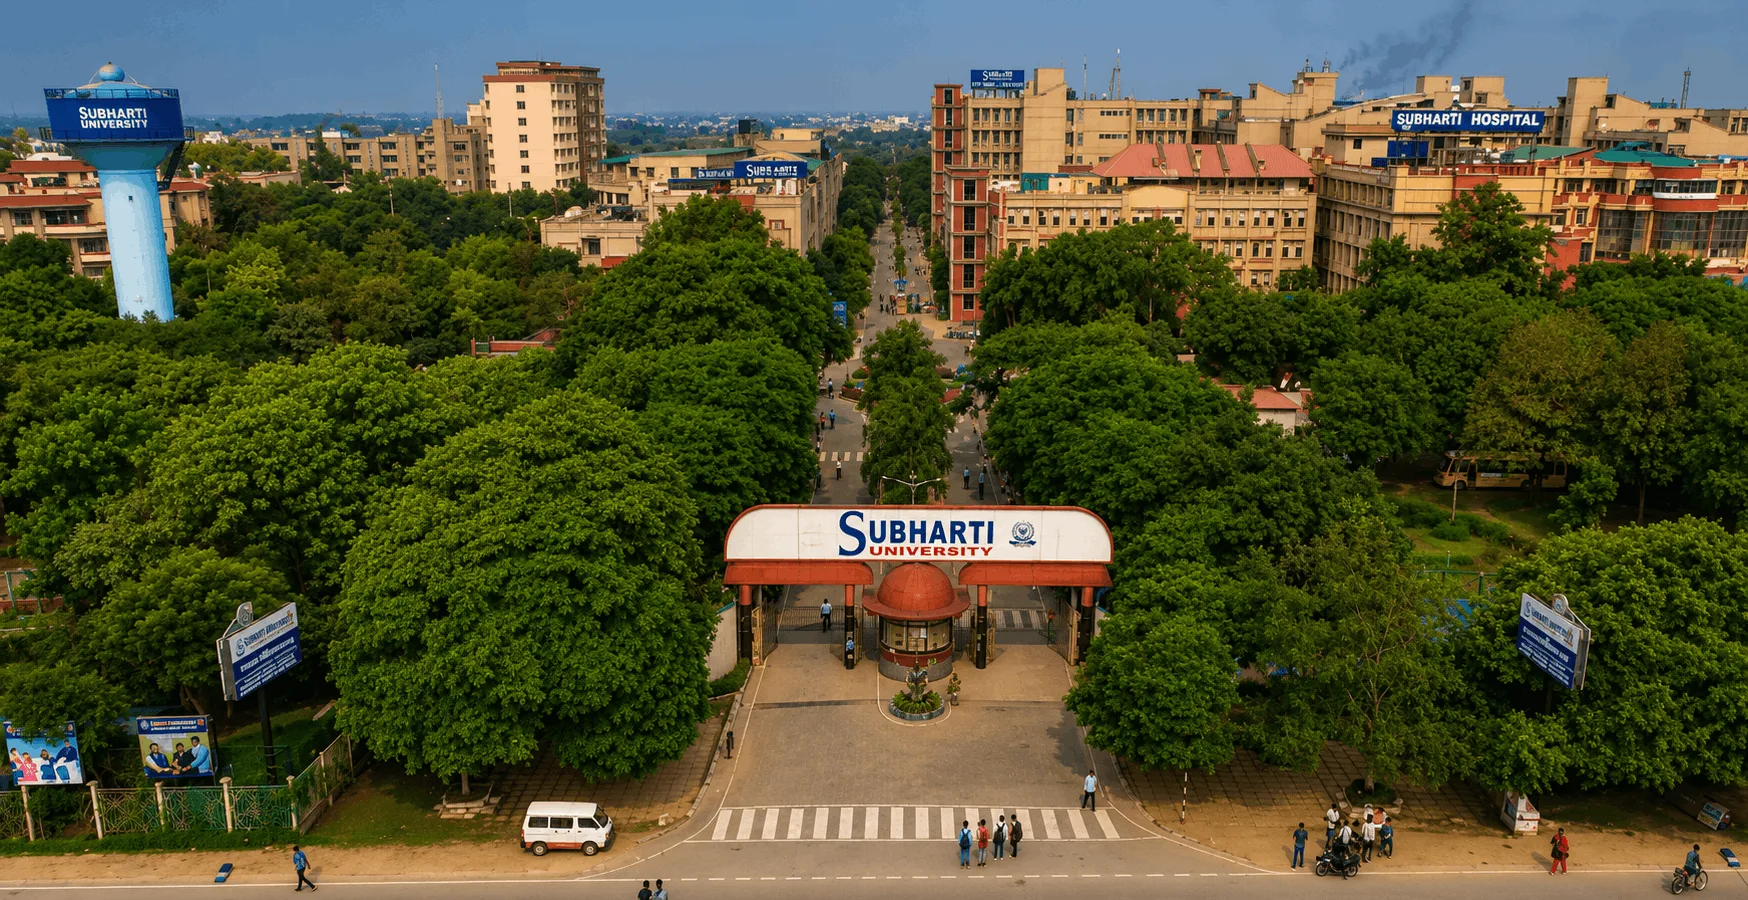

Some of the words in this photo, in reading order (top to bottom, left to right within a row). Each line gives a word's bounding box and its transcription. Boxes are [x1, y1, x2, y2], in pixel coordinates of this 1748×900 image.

[79, 106, 147, 119] SUBHARTI
[80, 119, 148, 129] UNIVERSITY
[1397, 113, 1462, 125] SUBHARTI
[1471, 113, 1540, 126] HOSPITAL
[839, 510, 994, 556] SUBHARTI
[869, 546, 993, 556] UNIVERSITY
